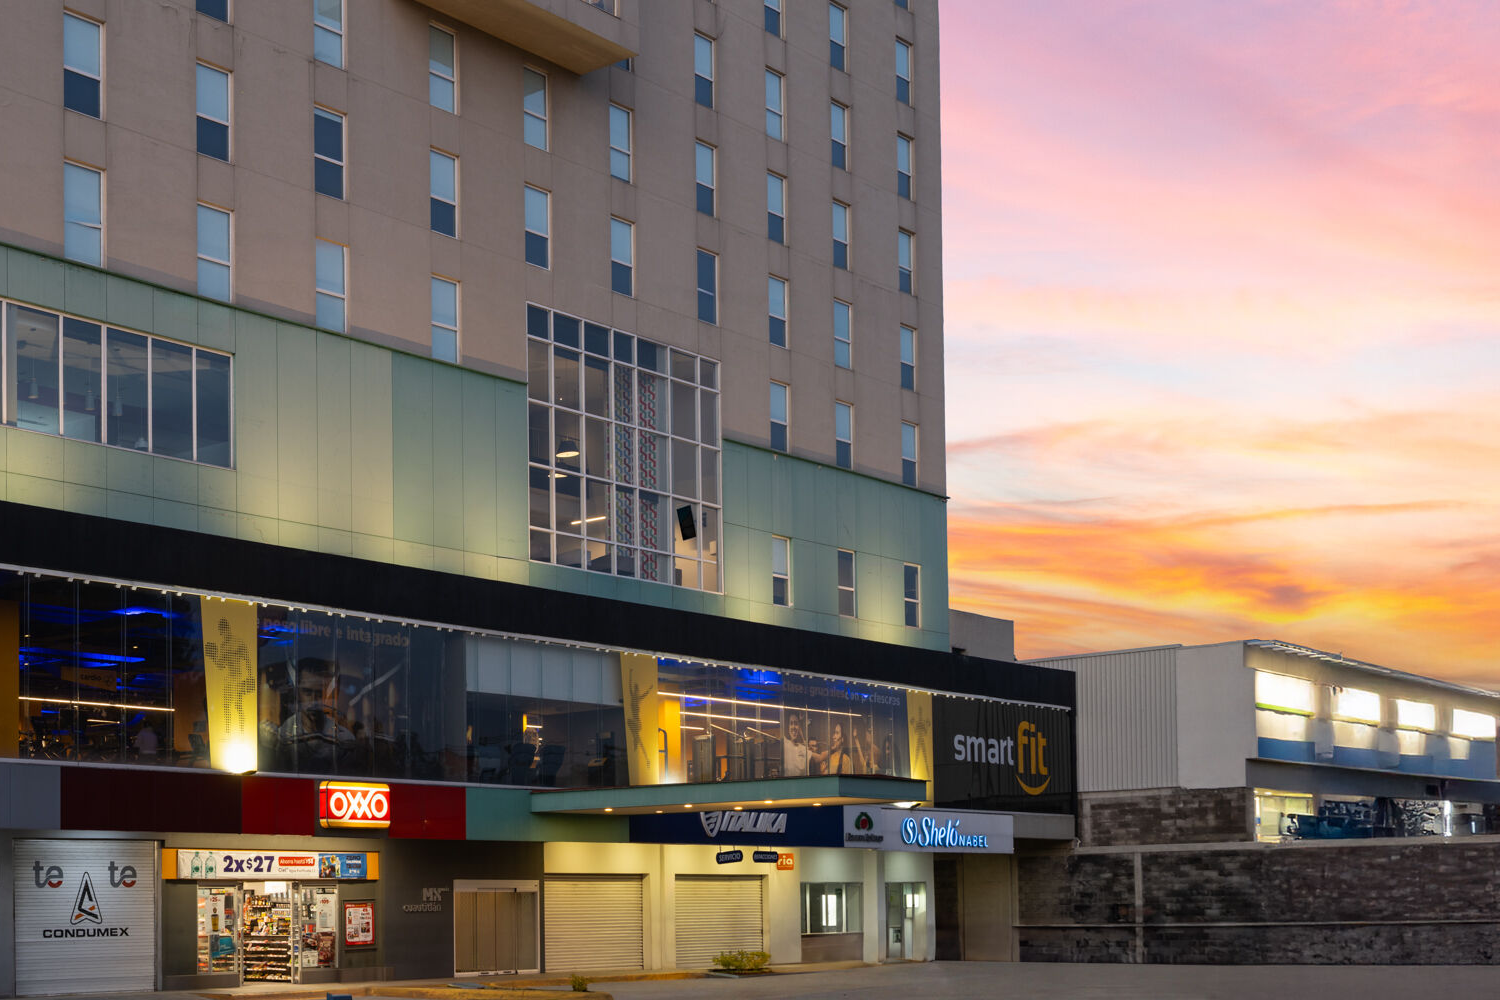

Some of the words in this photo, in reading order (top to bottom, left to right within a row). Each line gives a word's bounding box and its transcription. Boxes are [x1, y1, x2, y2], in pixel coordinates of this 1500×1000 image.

[300, 620, 332, 637] libre
[953, 734, 1015, 766] smart
[1017, 720, 1049, 776] fit
[329, 789, 389, 821] OXXO
[719, 810, 788, 834] ITALIKA
[918, 816, 961, 848] Sheló
[958, 835, 989, 848] NABEL
[222, 854, 275, 873] 2x$27
[777, 855, 794, 866] ria
[32, 860, 64, 889] te
[107, 860, 138, 889] te
[42, 927, 130, 939] CONDUMEX
